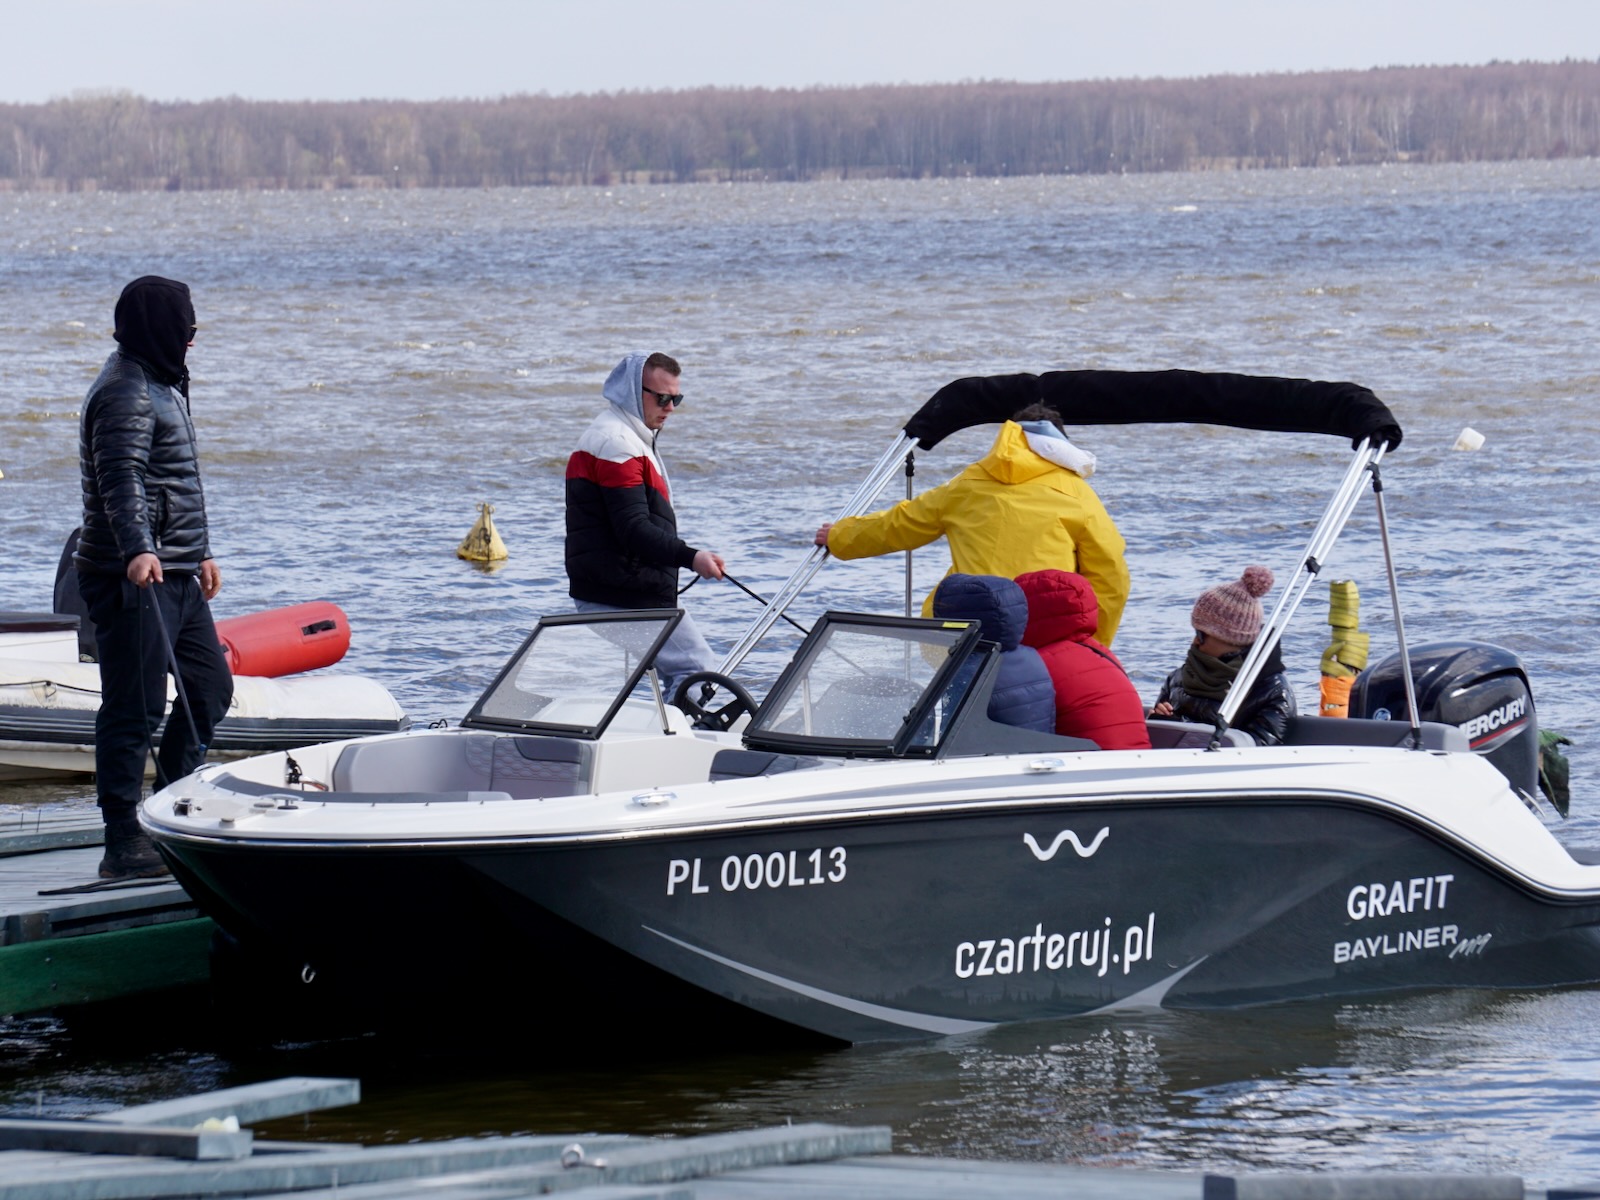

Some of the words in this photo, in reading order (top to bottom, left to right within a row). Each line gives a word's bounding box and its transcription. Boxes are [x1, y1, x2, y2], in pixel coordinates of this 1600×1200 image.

[666, 858, 710, 896] PL
[1347, 874, 1454, 921] GRAFIT
[955, 912, 1156, 978] czarteruj.pl
[1333, 924, 1459, 964] BAYLINER
